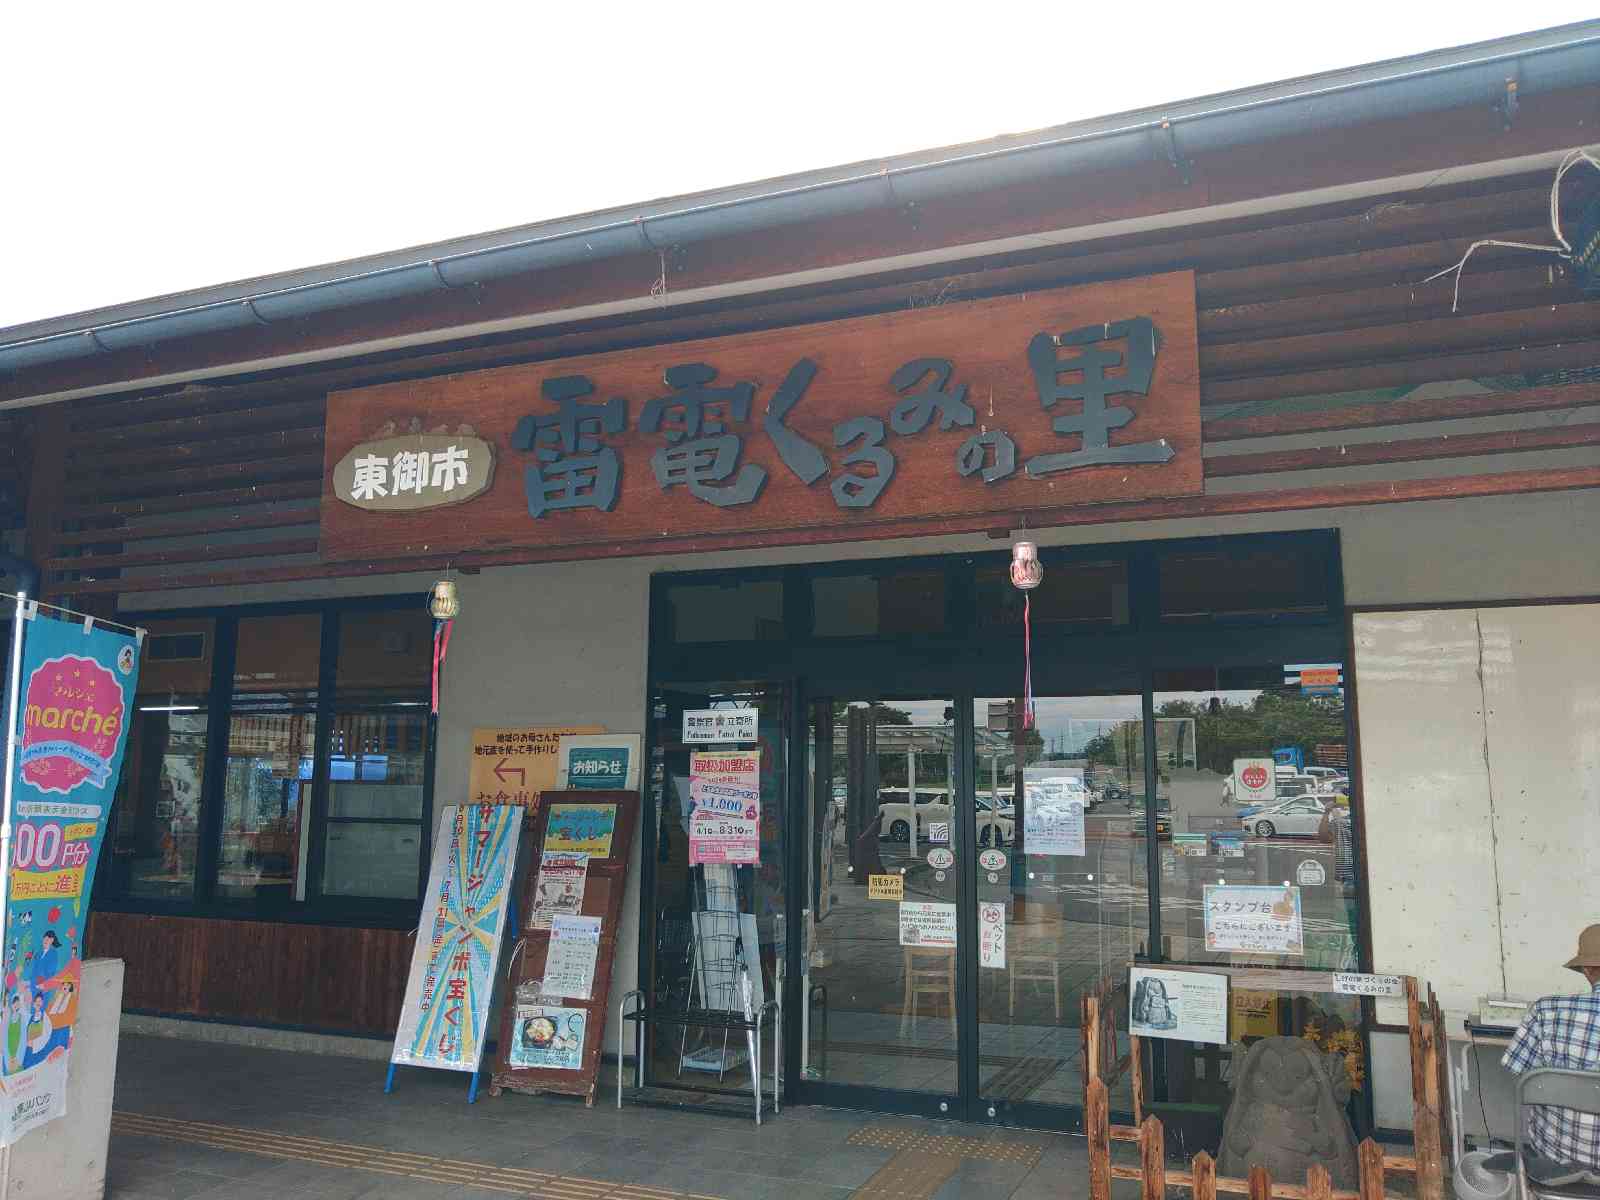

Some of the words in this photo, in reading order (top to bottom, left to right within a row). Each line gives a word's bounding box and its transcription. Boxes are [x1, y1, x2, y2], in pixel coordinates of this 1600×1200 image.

[511, 315, 1175, 519] 雷電くるみの里
[351, 445, 469, 502] 東御市
[25, 703, 120, 737] marché
[573, 760, 622, 775] お知らせ
[1209, 902, 1272, 913] スタンプ台
[992, 924, 1003, 954] ペット
